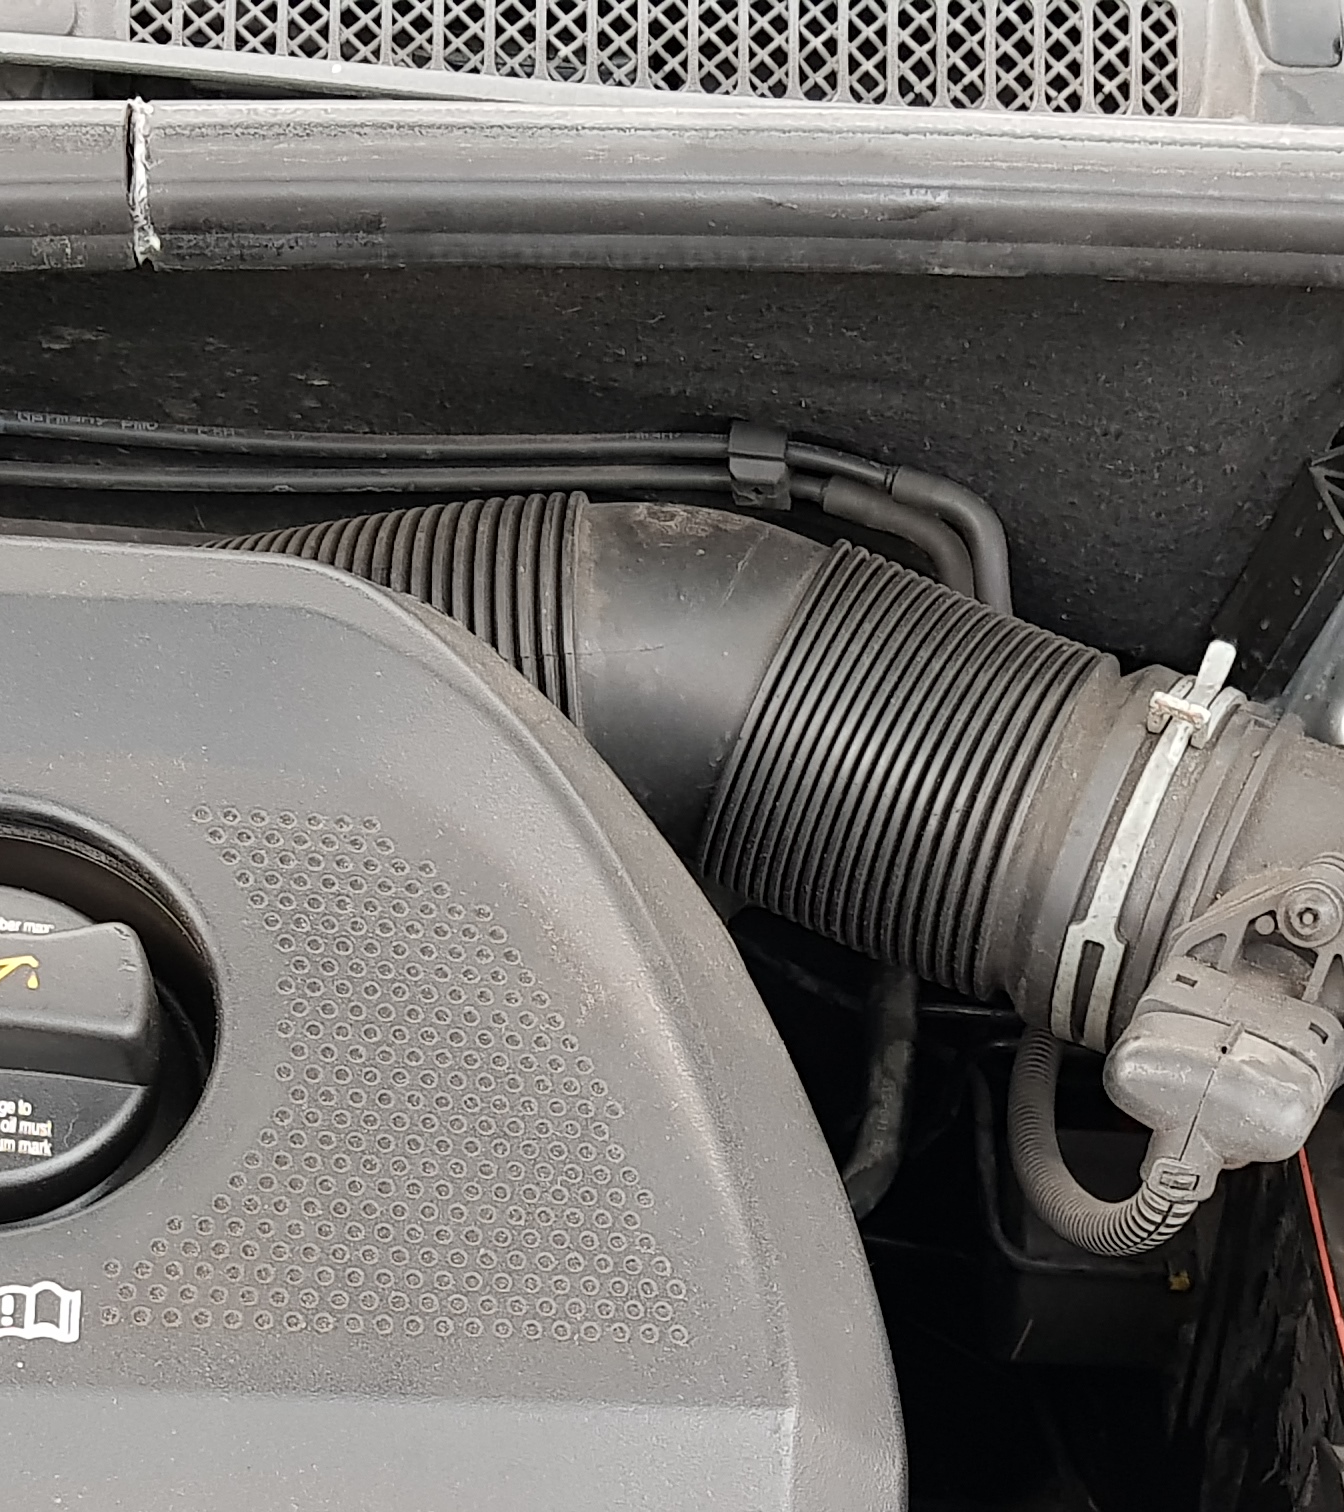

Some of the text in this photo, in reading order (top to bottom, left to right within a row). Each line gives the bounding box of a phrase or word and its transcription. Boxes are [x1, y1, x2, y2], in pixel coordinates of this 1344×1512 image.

[17, 1099, 32, 1117] to
[0, 1116, 17, 1133] oil
[18, 1120, 53, 1137] must
[17, 1141, 53, 1157] mark
